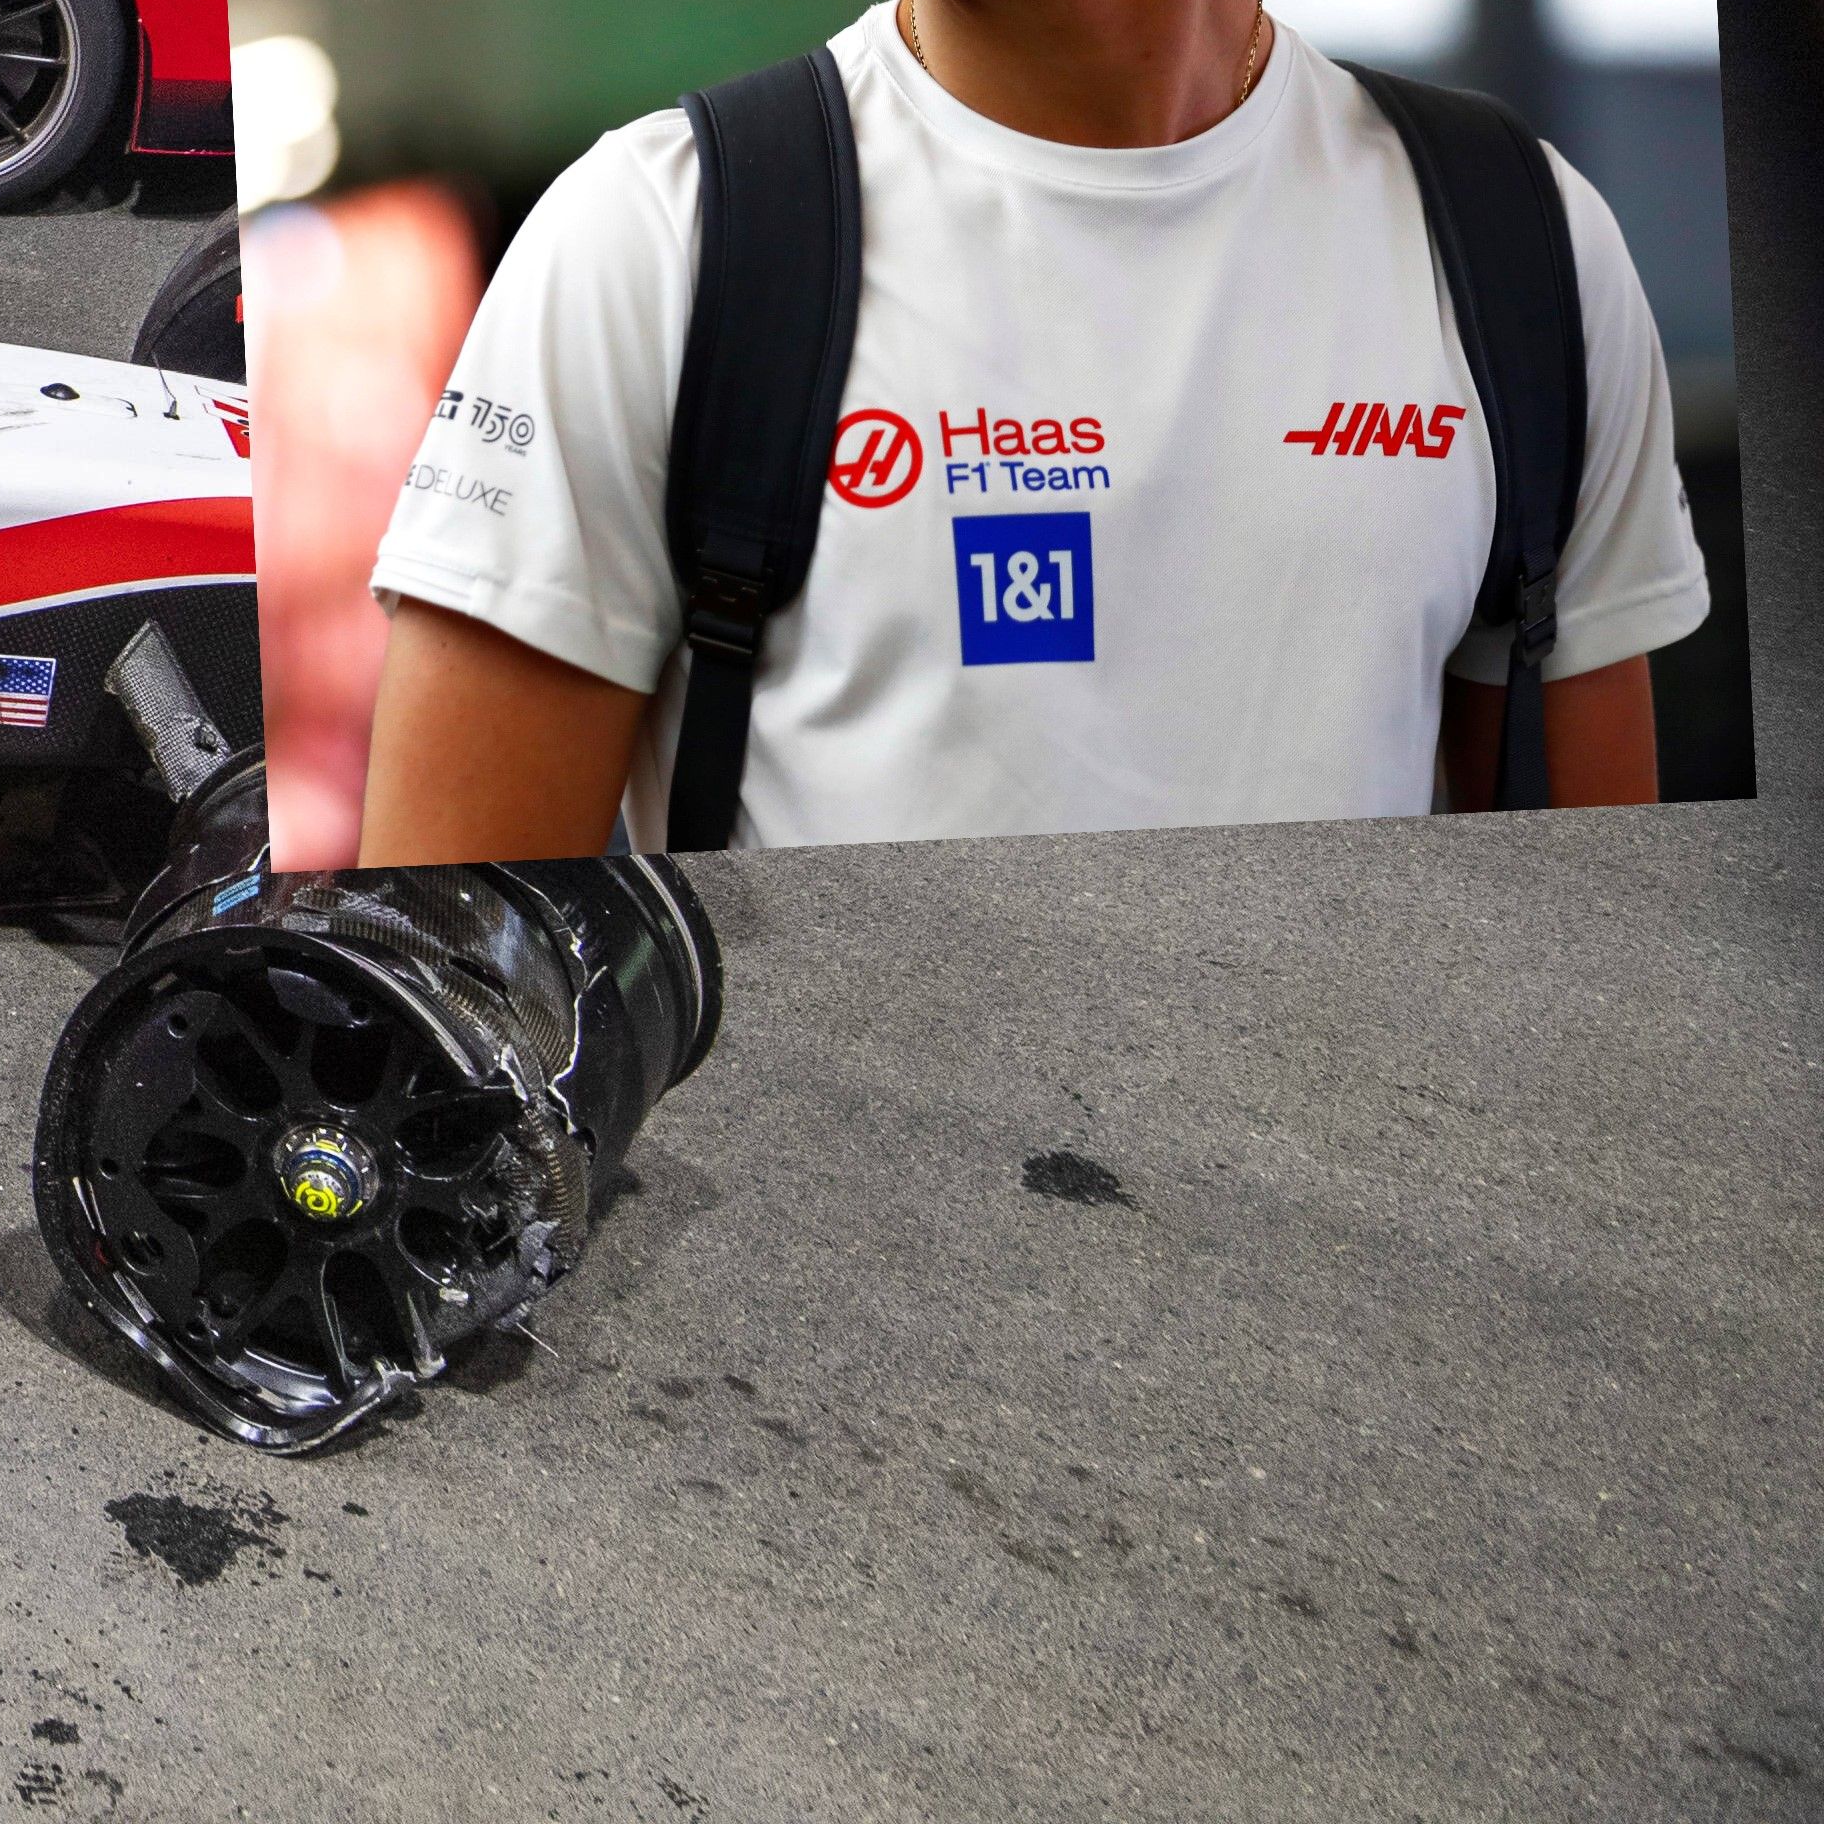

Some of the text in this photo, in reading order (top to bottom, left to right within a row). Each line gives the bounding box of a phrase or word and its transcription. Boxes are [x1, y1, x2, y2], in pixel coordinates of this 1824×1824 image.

[939, 407, 1106, 458] Haas
[1282, 402, 1467, 459] HAAS
[415, 464, 513, 517] DELUXE
[946, 460, 1111, 494] F1 Team
[969, 550, 1075, 623] 1&1
